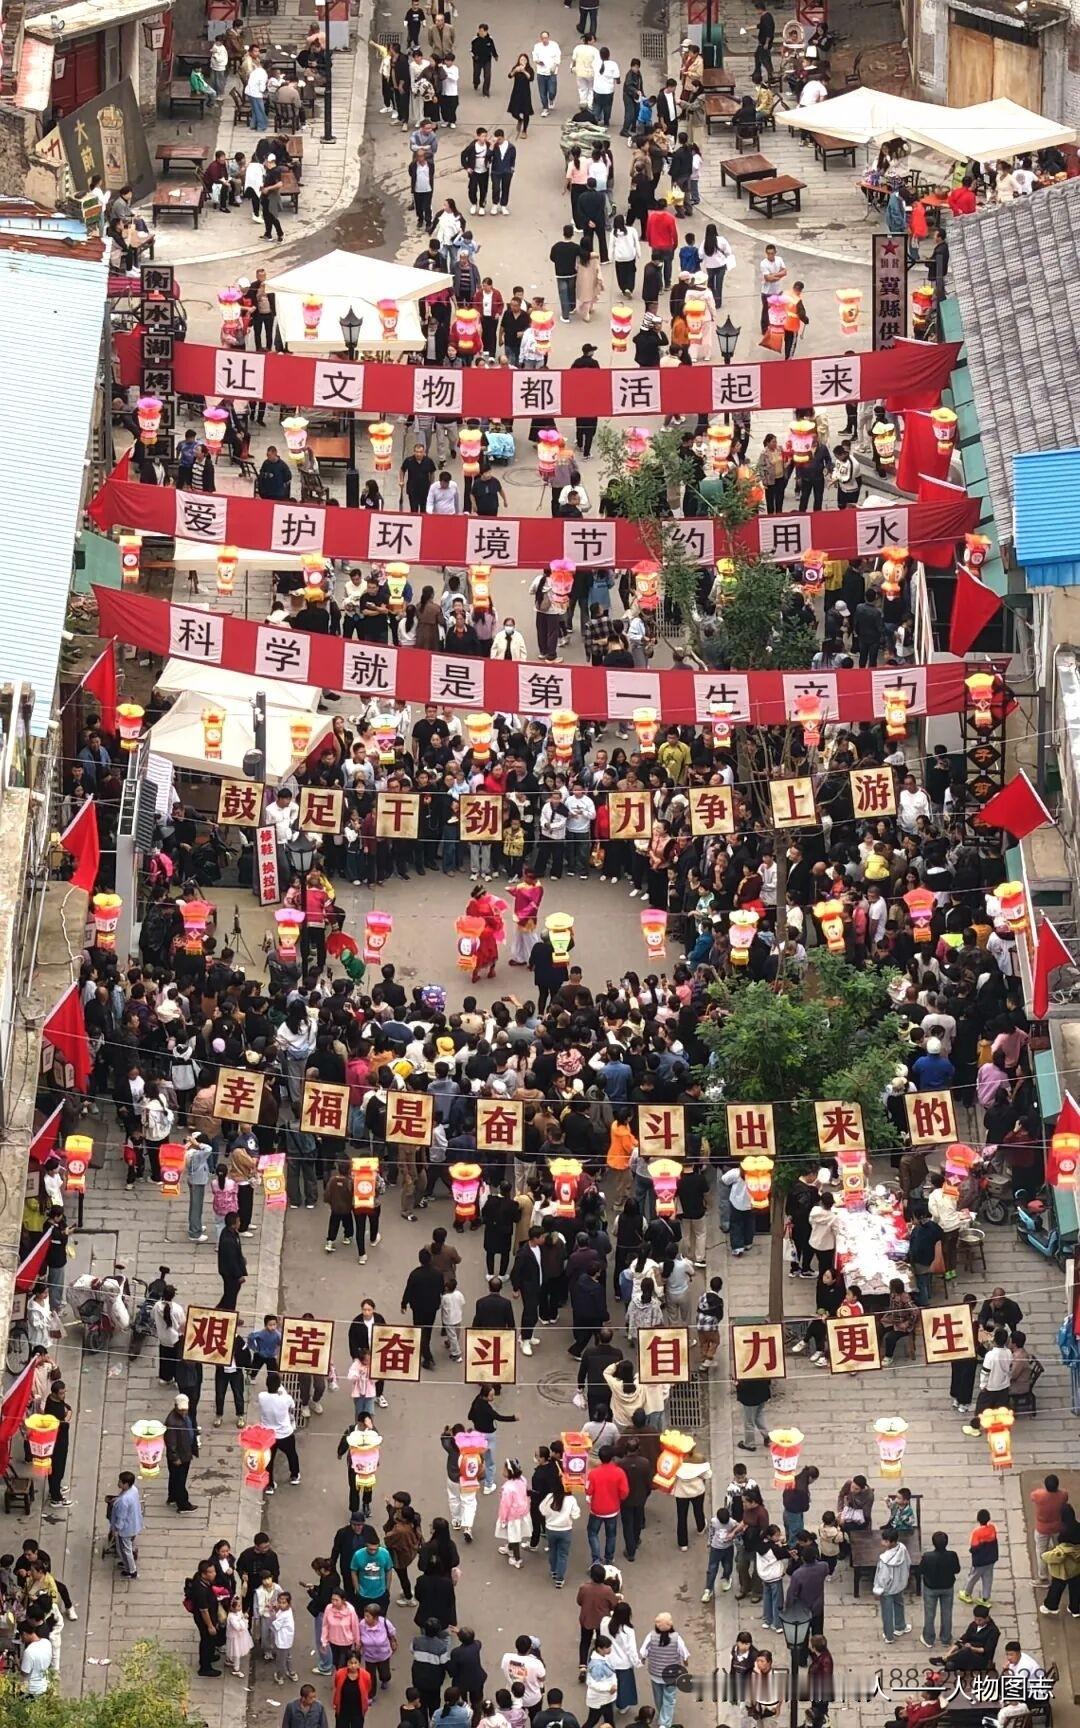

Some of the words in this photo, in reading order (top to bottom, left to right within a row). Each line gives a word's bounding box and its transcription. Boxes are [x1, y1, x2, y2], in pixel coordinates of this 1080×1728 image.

[75, 119, 97, 178] 大前
[879, 277, 901, 350] 冀縣供
[222, 357, 853, 411] 让文物都活起来
[184, 500, 900, 563] 爱护环境节约用水
[179, 617, 918, 715] 科学就是第一生产力
[221, 785, 498, 834] 鼓足干劲
[616, 773, 891, 833] 力争上游
[220, 1076, 951, 1150] 幸福是奋斗出来的
[188, 1316, 508, 1376] 艰苦奋斗
[646, 1314, 969, 1376] 自力更生
